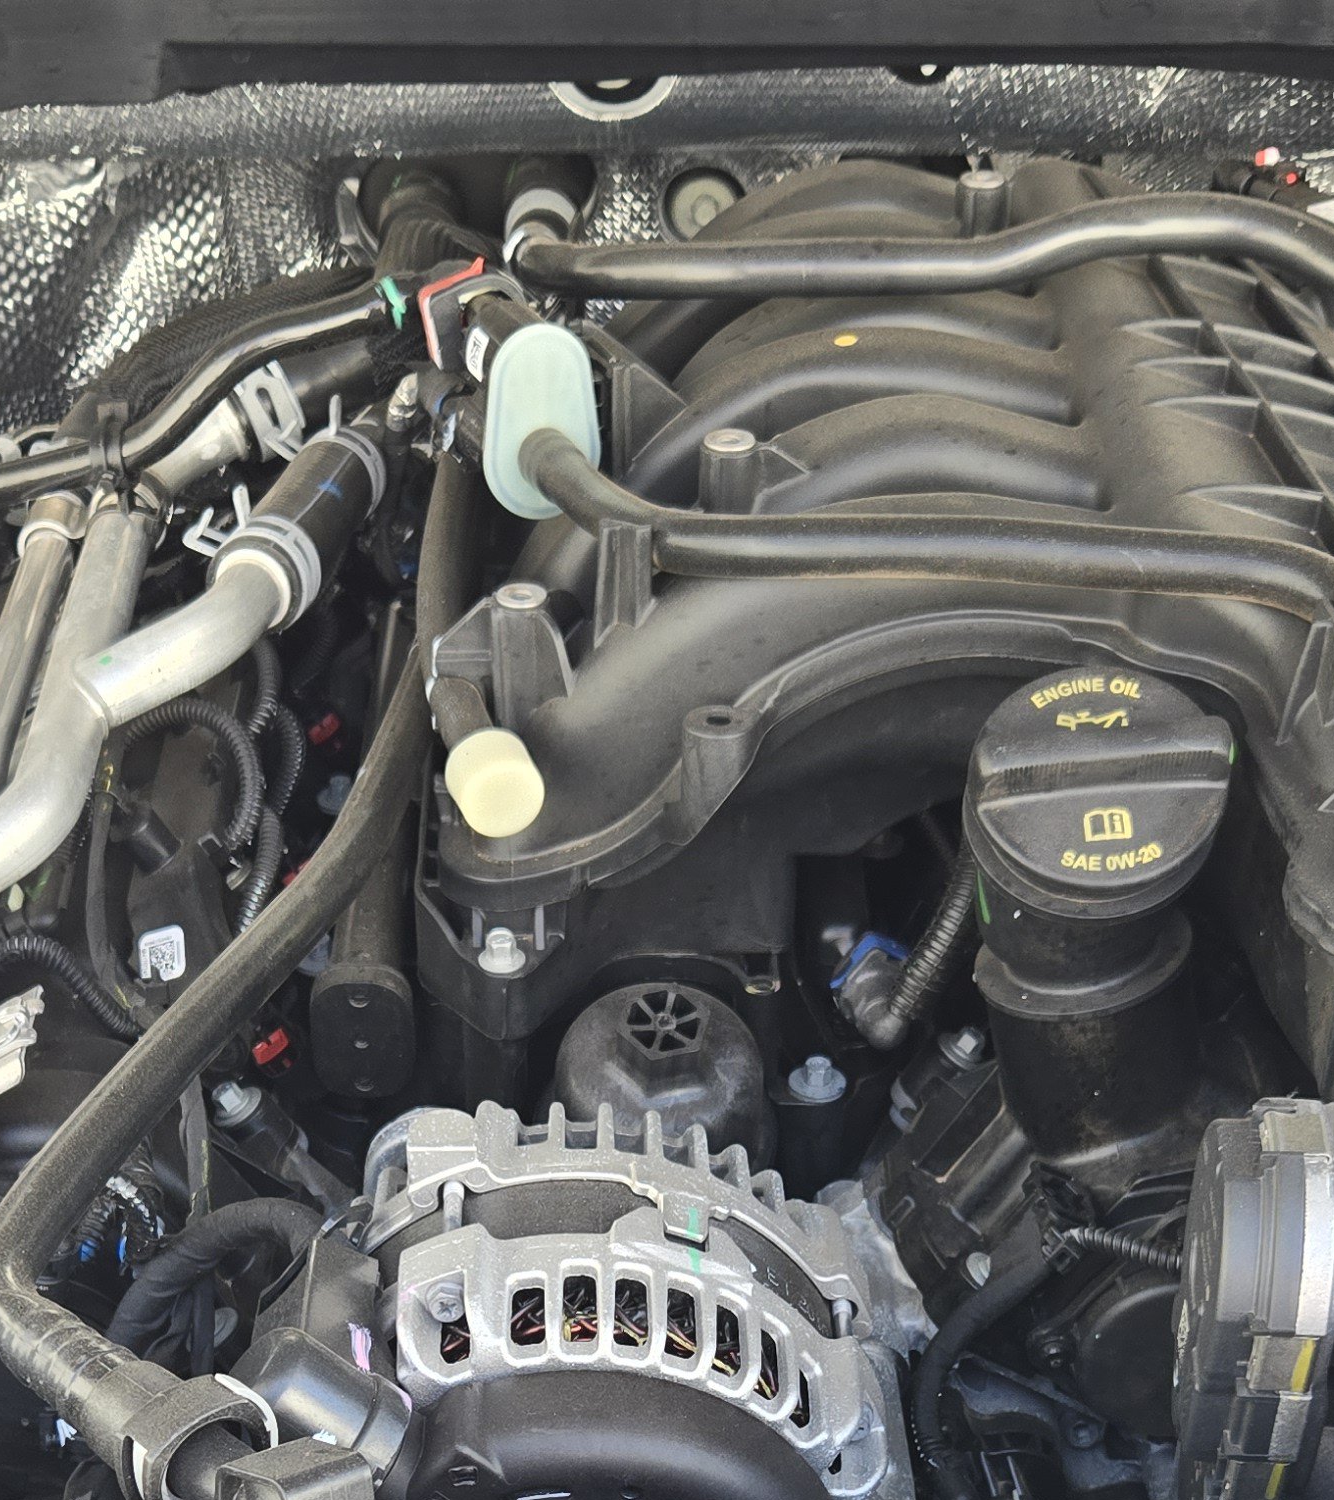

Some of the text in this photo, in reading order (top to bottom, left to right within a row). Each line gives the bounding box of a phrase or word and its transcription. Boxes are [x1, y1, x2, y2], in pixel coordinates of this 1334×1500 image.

[1030, 677, 1142, 710] ENGINE OIL
[1060, 842, 1162, 872] SAE 0W-20
